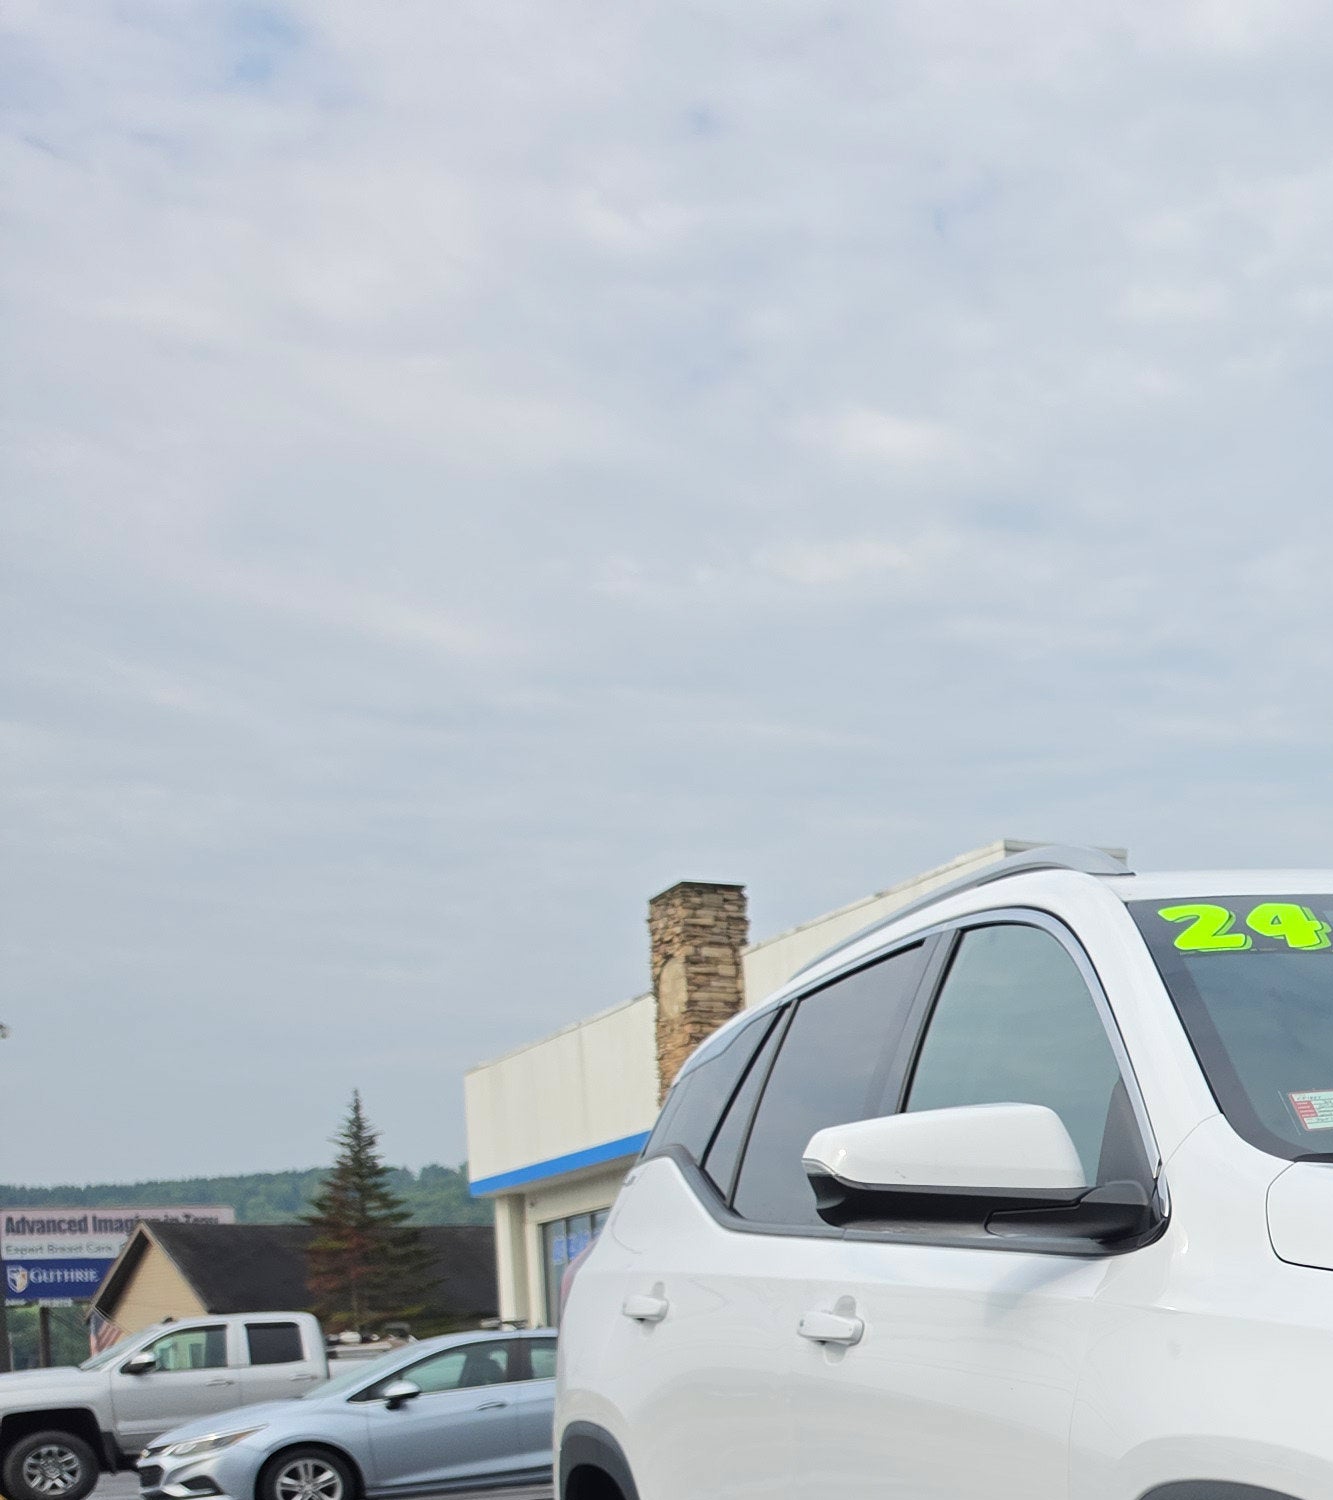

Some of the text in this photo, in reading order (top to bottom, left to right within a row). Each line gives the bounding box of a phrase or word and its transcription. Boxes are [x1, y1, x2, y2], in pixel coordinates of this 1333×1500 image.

[1157, 902, 1332, 952] 24
[5, 1214, 89, 1236] Advanced
[29, 1266, 100, 1283] GUTHRIE
